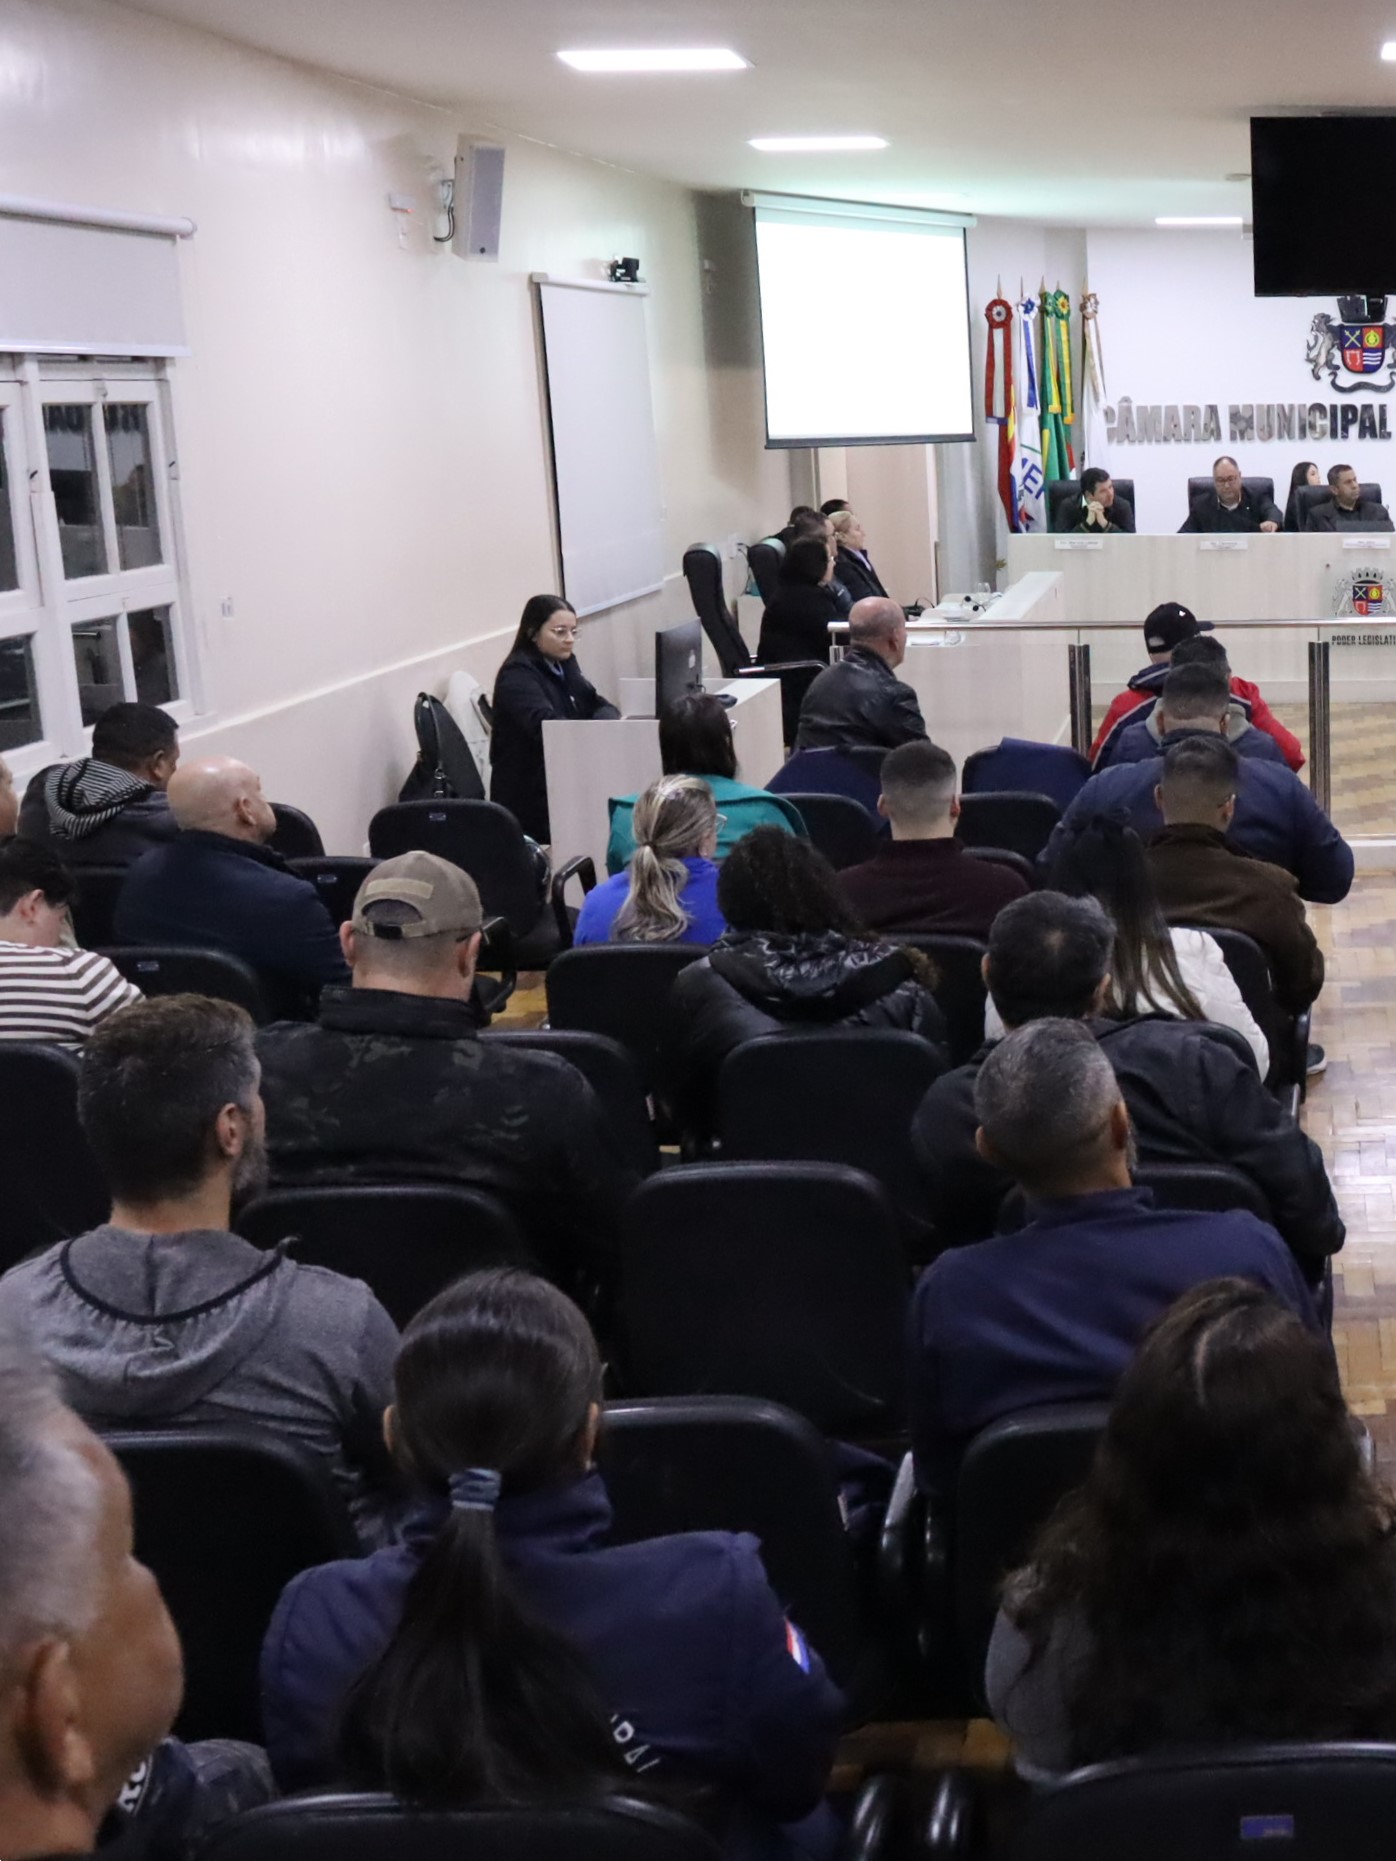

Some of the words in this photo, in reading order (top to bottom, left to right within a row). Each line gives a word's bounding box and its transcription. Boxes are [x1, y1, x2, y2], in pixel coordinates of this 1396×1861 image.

[1104, 395, 1222, 443] CÂMARA
[1229, 402, 1392, 442] MUNICIPAL
[1331, 634, 1356, 646] PODER
